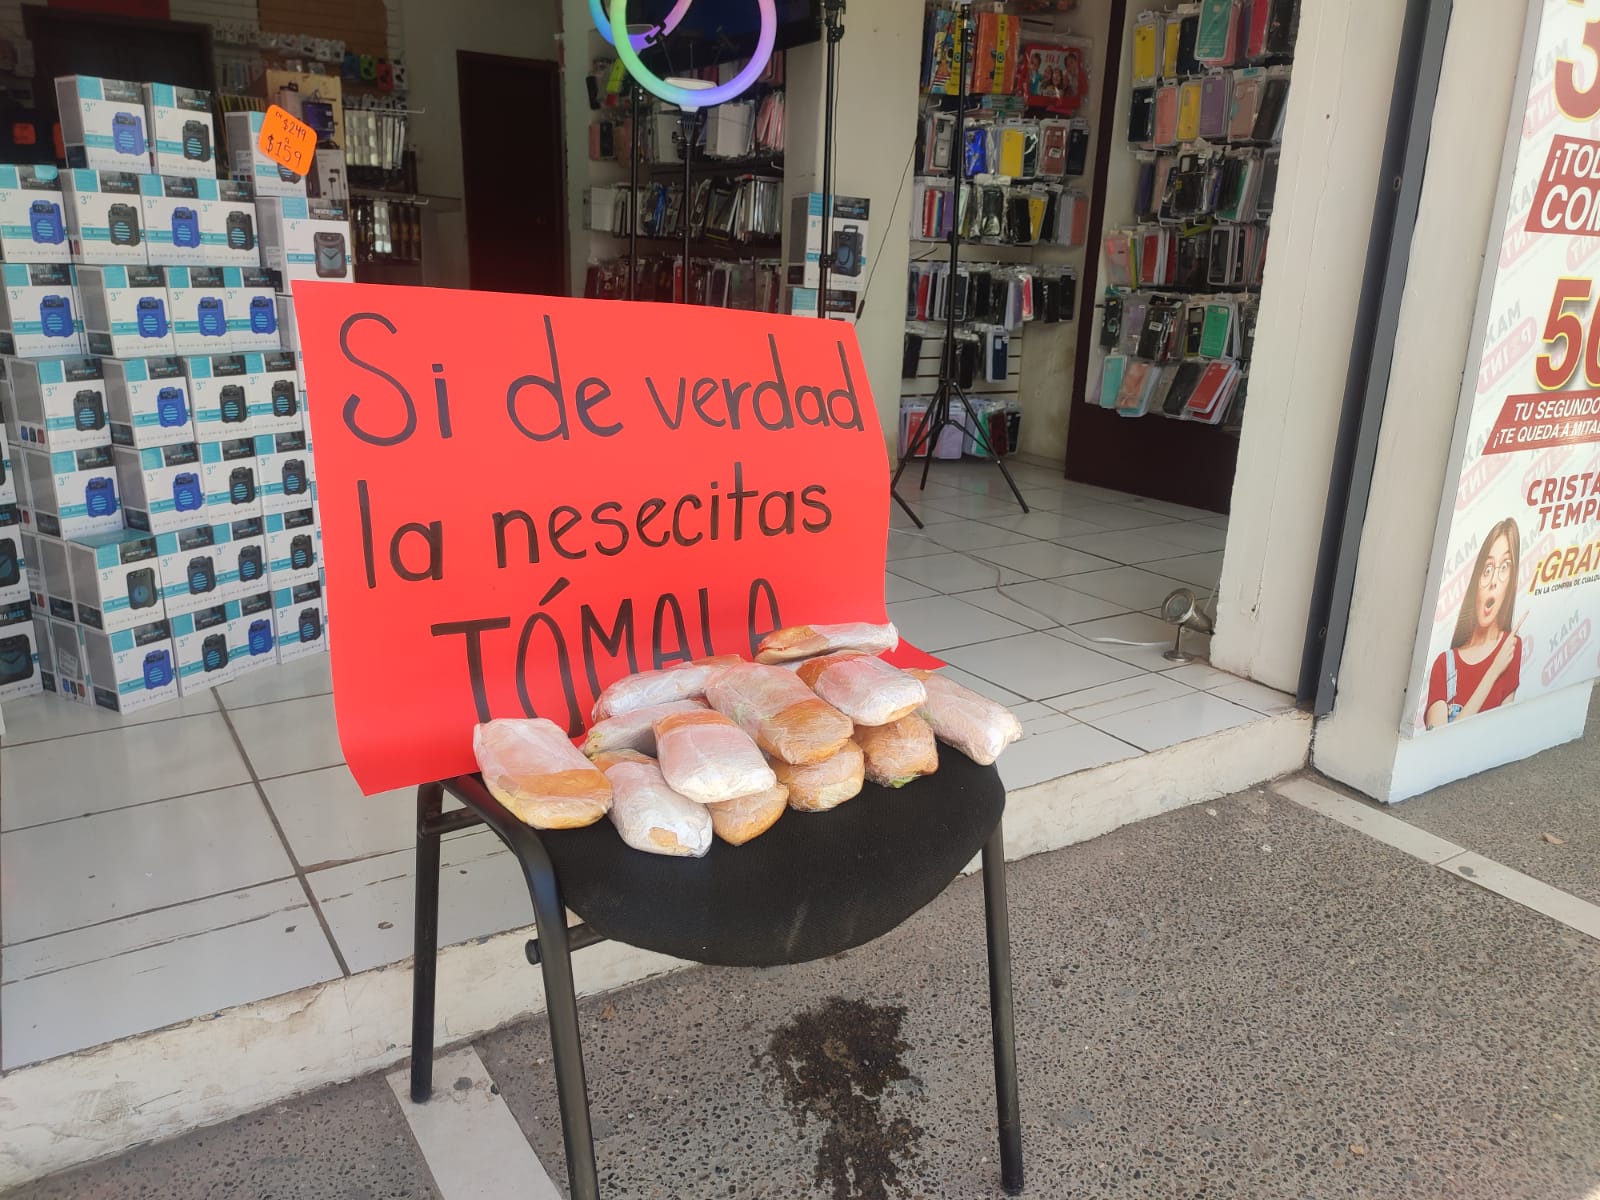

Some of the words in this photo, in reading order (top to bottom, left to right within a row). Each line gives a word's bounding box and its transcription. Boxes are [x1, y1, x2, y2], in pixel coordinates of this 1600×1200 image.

[283, 119, 306, 141] $249
[266, 133, 302, 168] $159
[339, 312, 453, 447] Si
[506, 315, 624, 442] de
[645, 333, 865, 433] verdad
[1514, 402, 1534, 422] TU
[1493, 428, 1516, 449] ¡TE
[1517, 423, 1558, 443] QUEDA
[1559, 422, 1570, 438] A
[356, 480, 444, 589] la
[493, 461, 833, 569] nesecitas
[1539, 498, 1600, 532] TEMP
[1534, 588, 1543, 596] EN
[1543, 586, 1550, 594] LA
